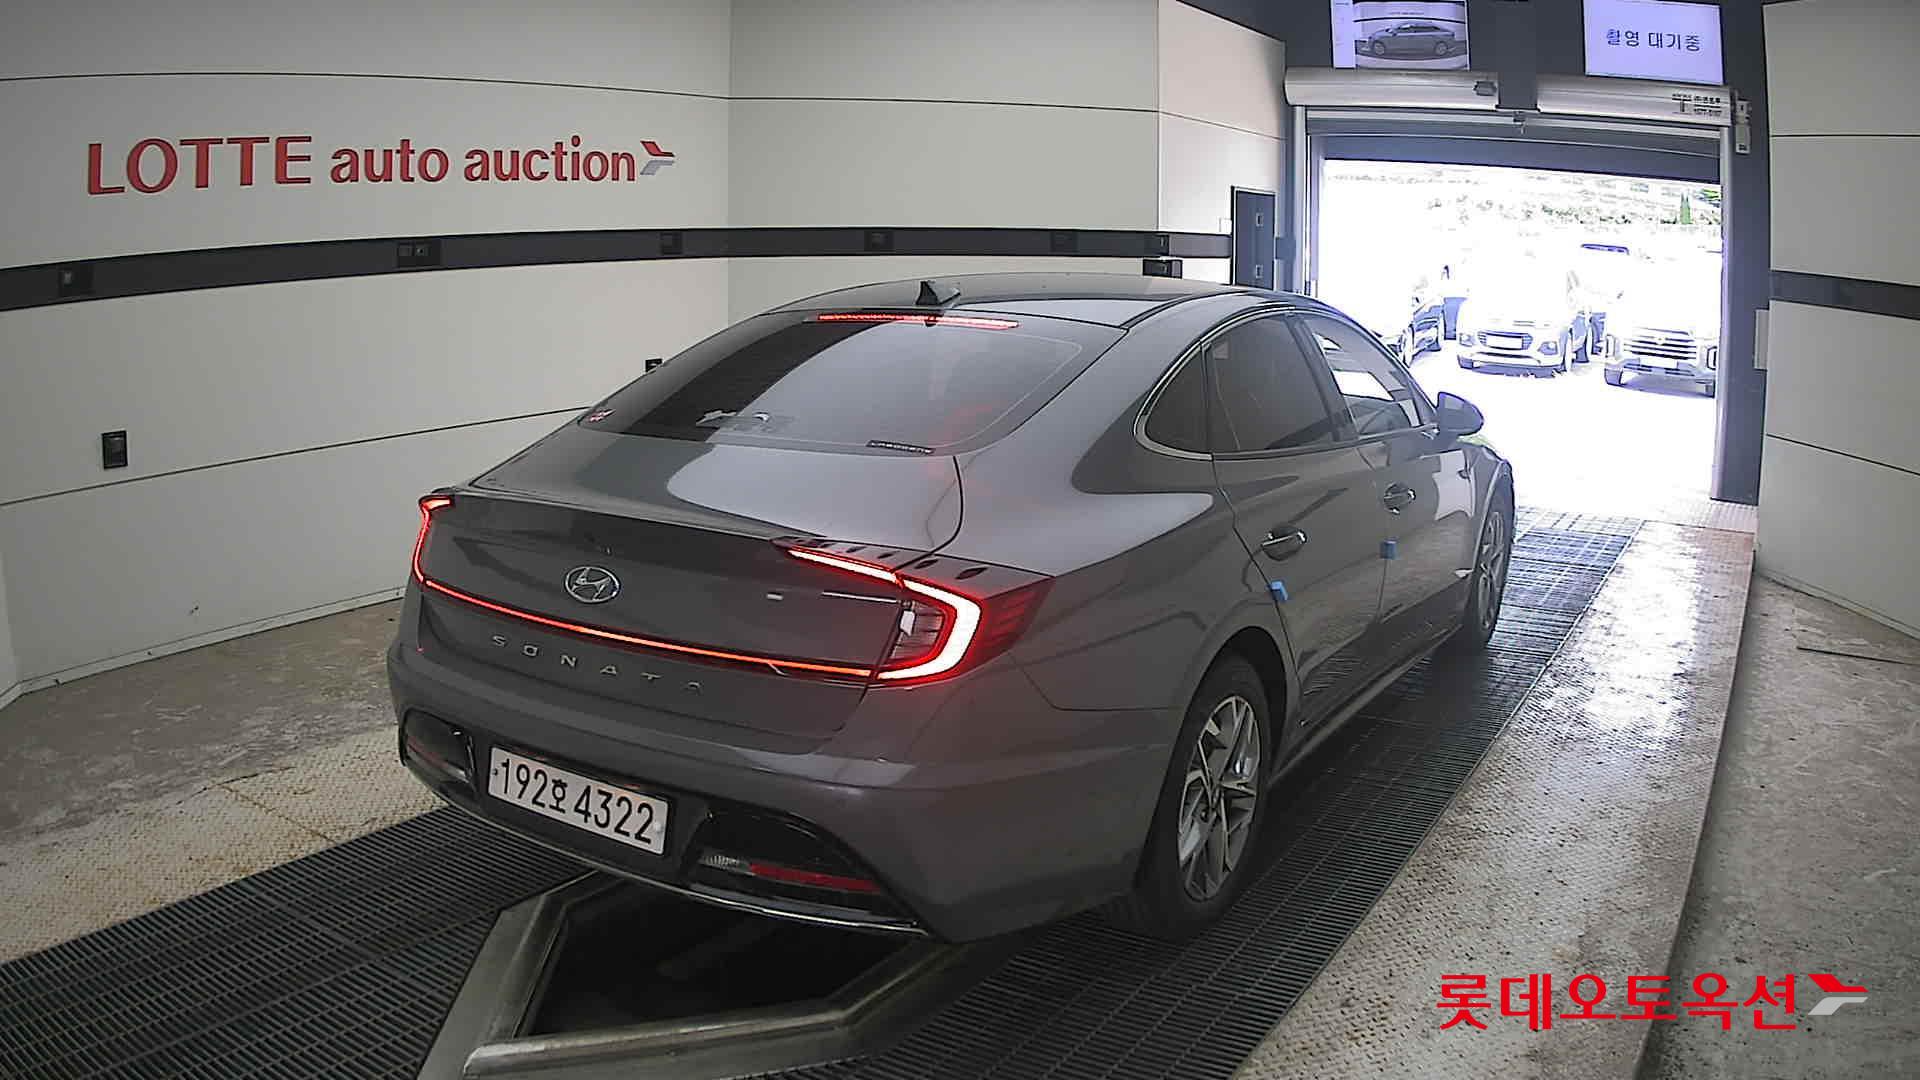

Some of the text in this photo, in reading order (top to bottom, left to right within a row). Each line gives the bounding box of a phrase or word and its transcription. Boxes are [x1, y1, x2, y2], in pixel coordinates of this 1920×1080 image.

[1648, 32, 1701, 52] 대기중
[87, 135, 636, 195] LOTTE auto auction
